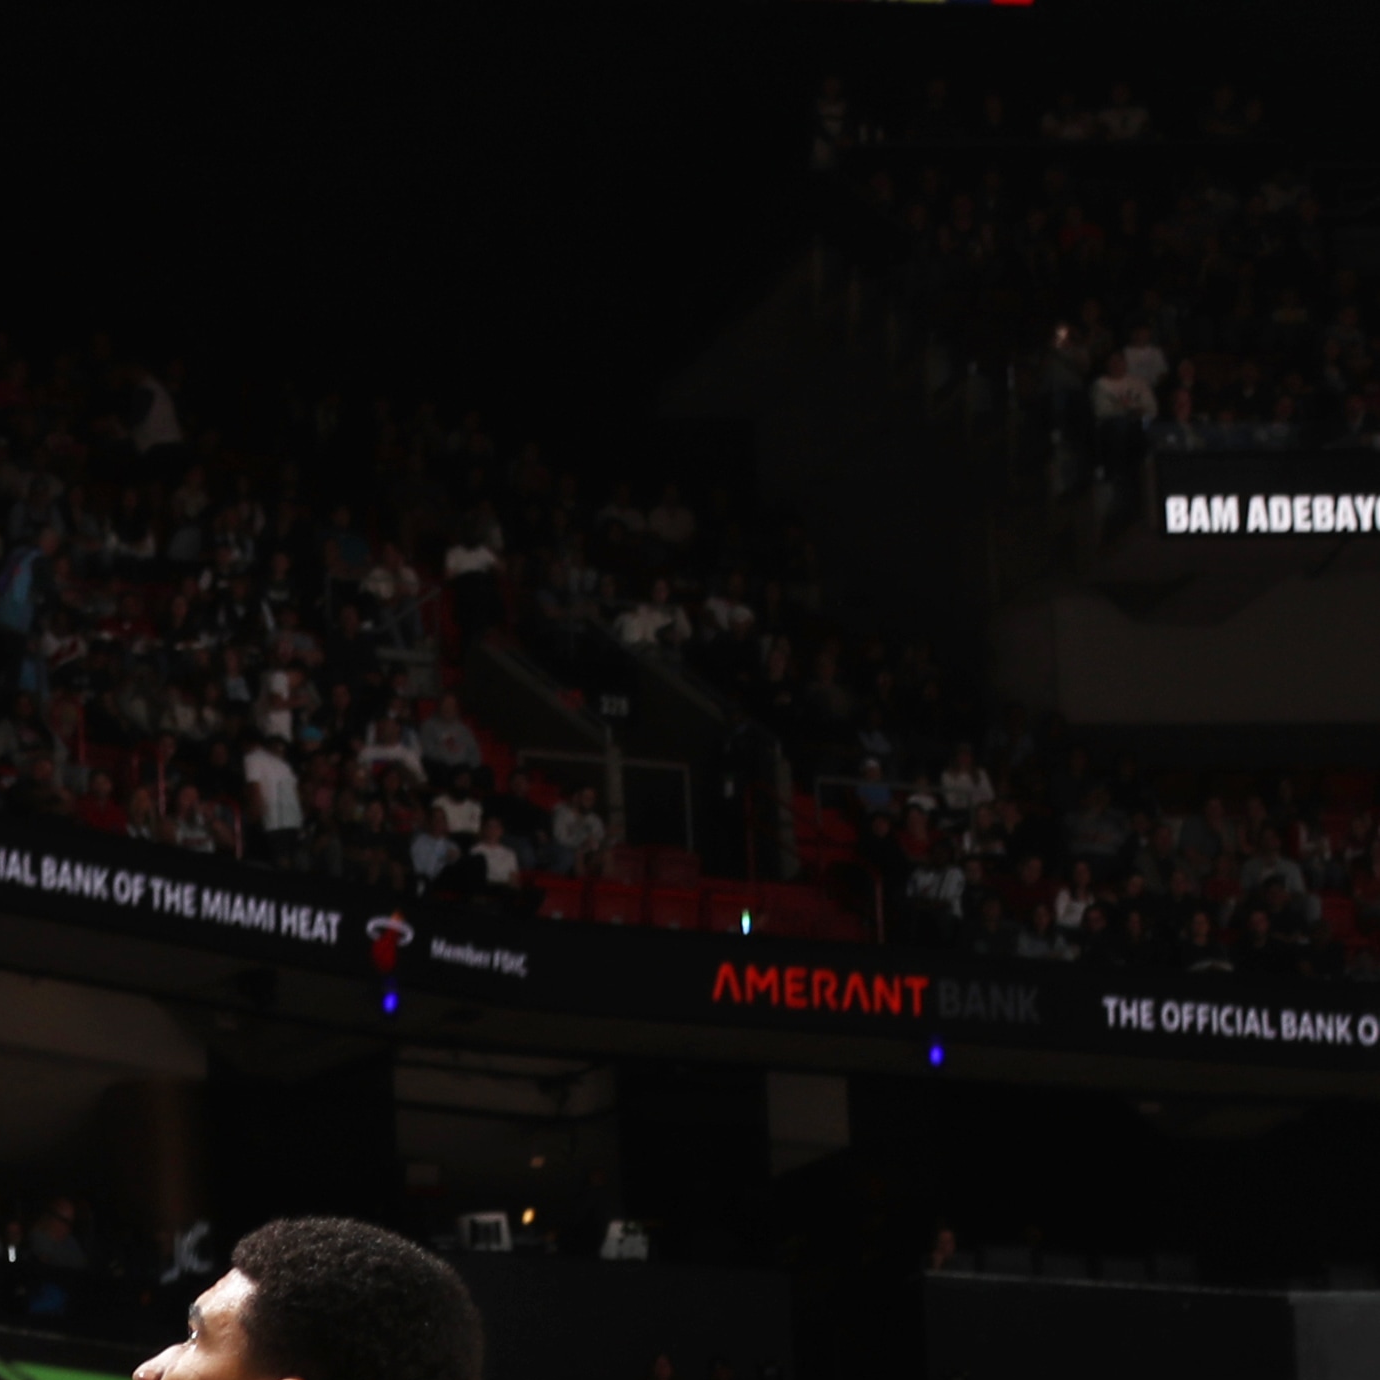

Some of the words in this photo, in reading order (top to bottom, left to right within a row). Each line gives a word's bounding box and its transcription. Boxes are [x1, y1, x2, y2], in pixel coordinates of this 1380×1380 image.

[1165, 494, 1239, 533] BAM
[1246, 494, 1380, 533] ADEBAY
[40, 856, 108, 900] BANK
[112, 871, 147, 906] OF
[150, 877, 196, 920] THE
[200, 887, 276, 934] MIAMI
[280, 904, 342, 944] HEAT
[713, 961, 929, 1017] AMERANT
[937, 978, 1040, 1024] BANK
[1103, 996, 1155, 1031] THE
[1160, 1001, 1277, 1040] OFFICIAL
[1280, 1009, 1353, 1045] BANK
